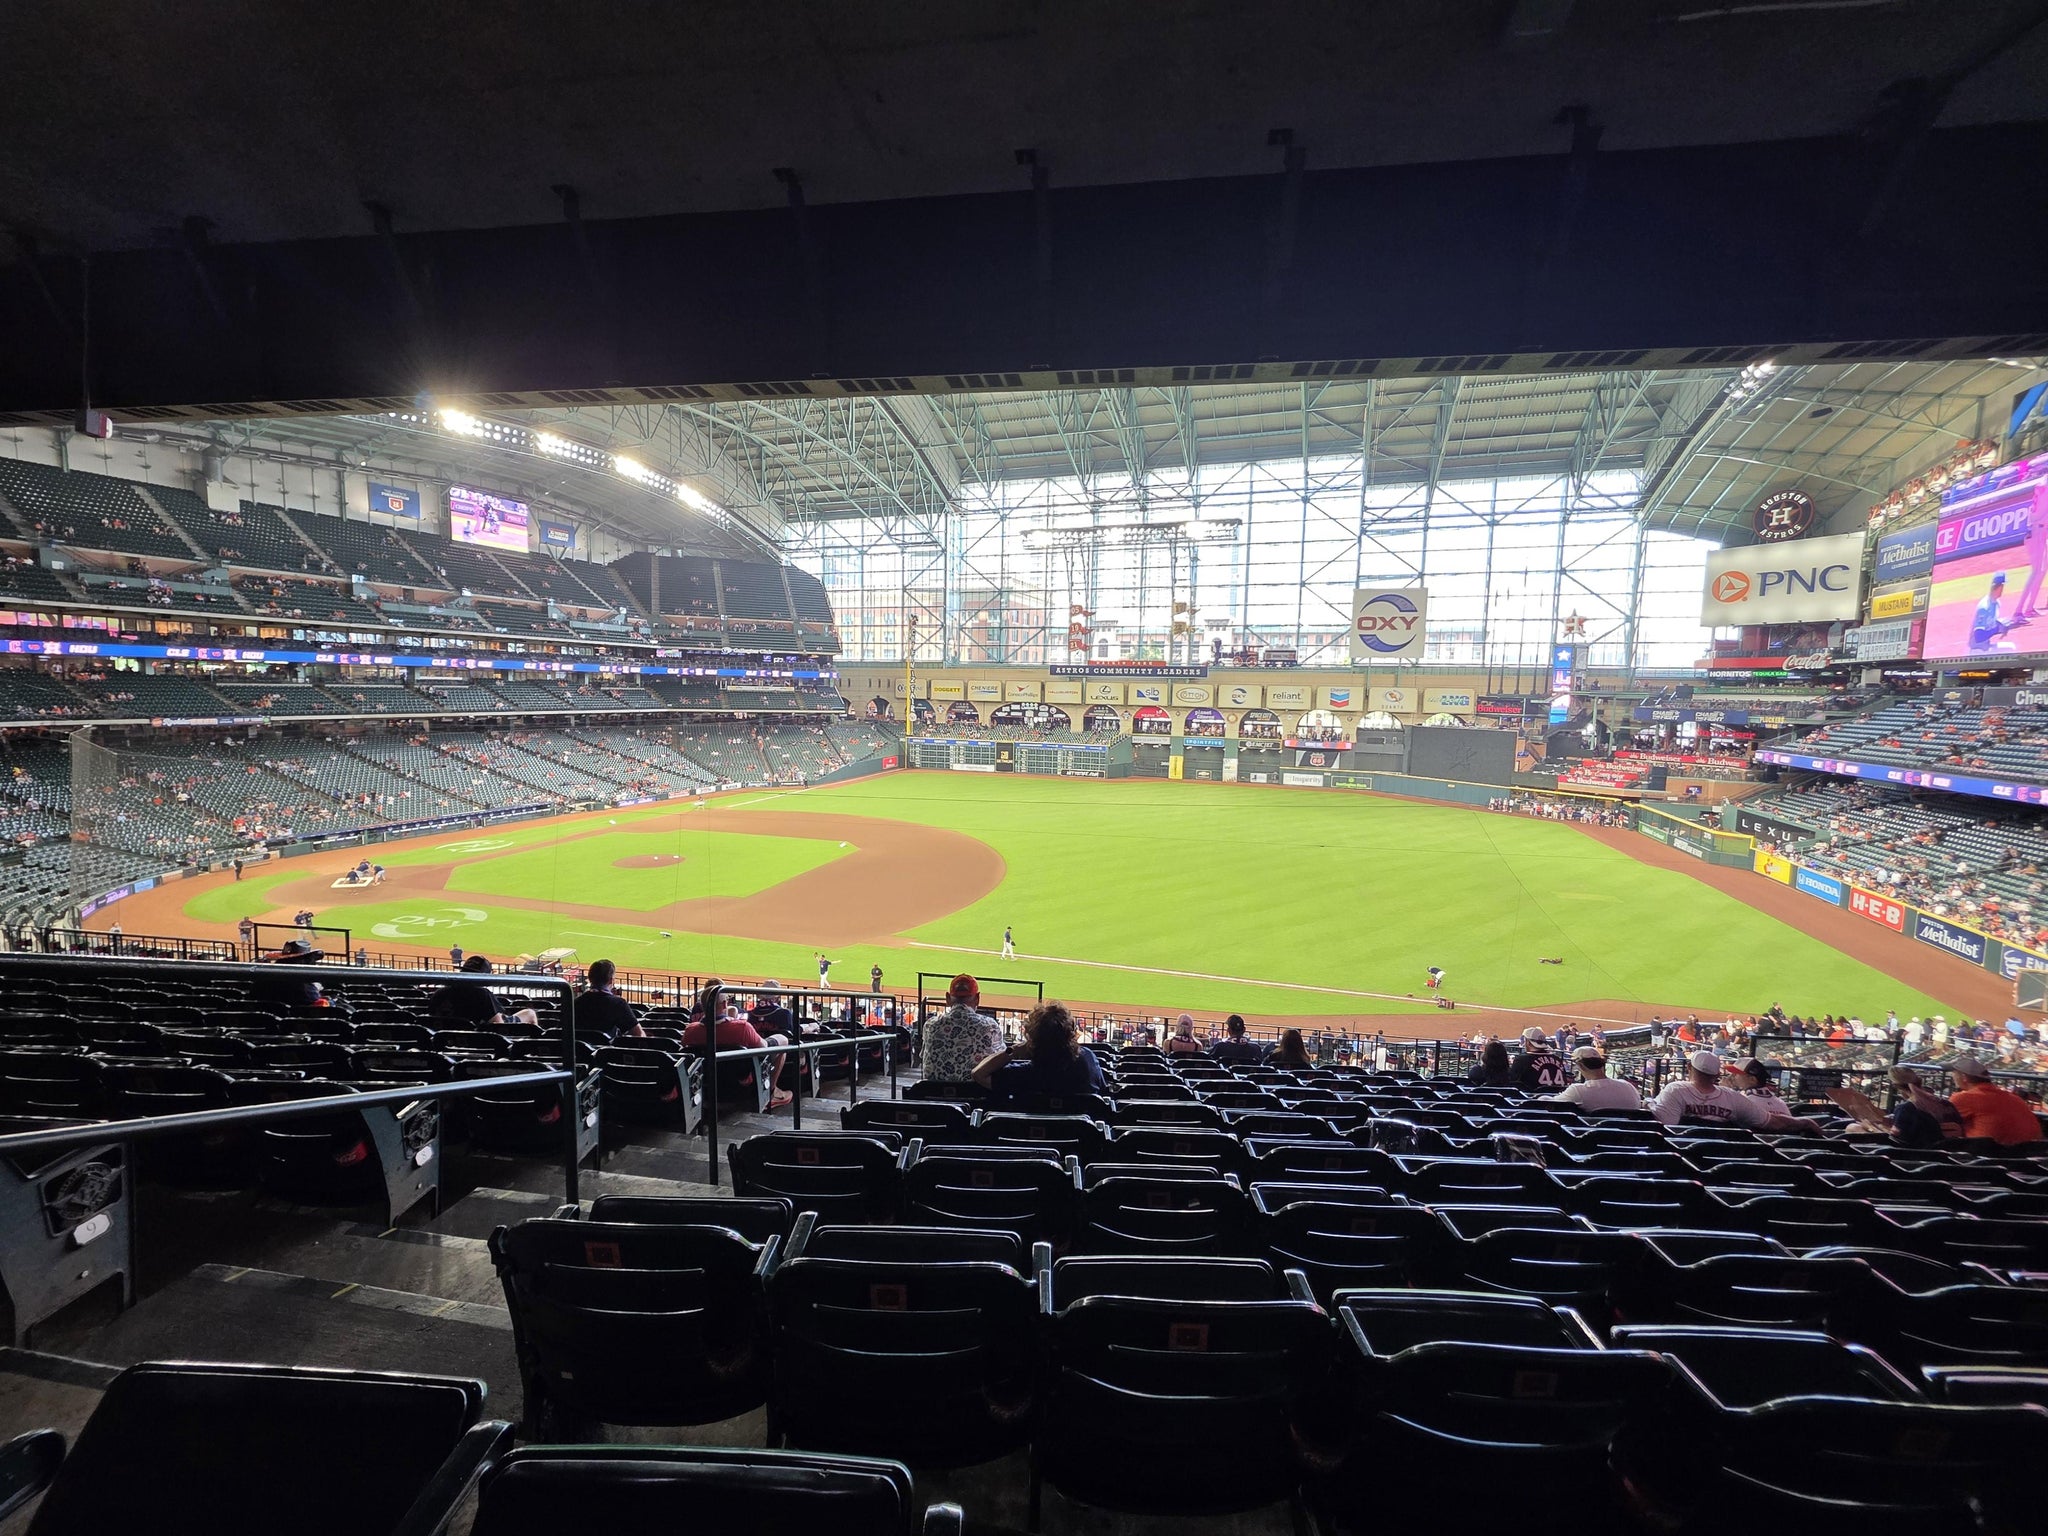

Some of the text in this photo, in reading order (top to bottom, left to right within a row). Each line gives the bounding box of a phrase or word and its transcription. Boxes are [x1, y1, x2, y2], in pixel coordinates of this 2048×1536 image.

[1760, 492, 1808, 511] HOUSTON
[1769, 506, 1793, 526] H
[1760, 524, 1802, 539] ASTROS
[1880, 540, 1931, 567] Methodist
[1756, 564, 1850, 597] PNC
[1878, 593, 1926, 612] MUSTANG CAT
[1357, 616, 1419, 630] OXY
[1094, 667, 1153, 675] COMMUNITY
[1157, 667, 1201, 676] LEADERS
[1145, 688, 1160, 696] slb
[1272, 691, 1302, 700] reliant
[1441, 695, 1470, 706] LNG
[1477, 704, 1521, 714] Budweiser
[1805, 877, 1839, 896] HONDA
[1920, 917, 1944, 929] HOUSTON
[1920, 926, 1979, 959] Methodist
[1538, 1069, 1565, 1087] 44
[1684, 1103, 1732, 1119] ALVAREZ
[86, 1222, 97, 1235] 9
